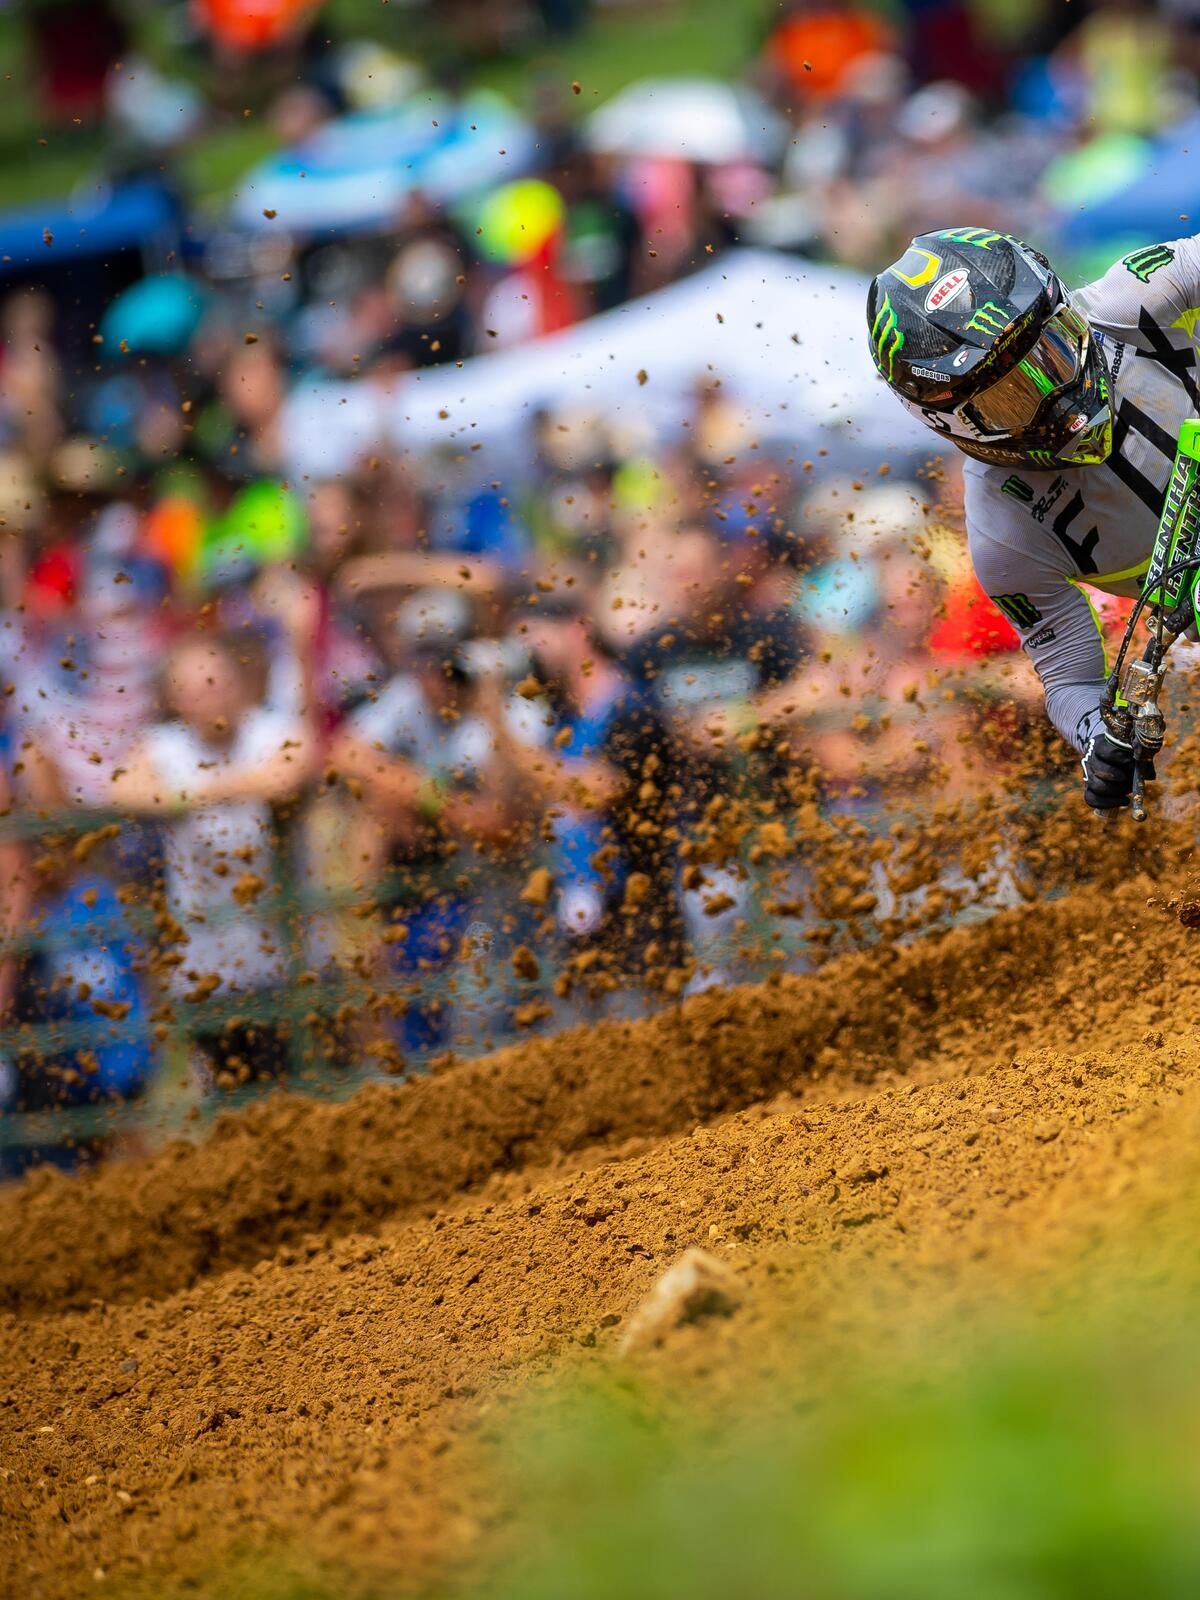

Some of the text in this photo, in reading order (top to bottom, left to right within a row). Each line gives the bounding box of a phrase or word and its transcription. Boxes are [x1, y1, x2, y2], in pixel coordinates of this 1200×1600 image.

[930, 274, 966, 307] BELL
[1071, 416, 1086, 431] BELL
[1147, 454, 1192, 589] RENTHA
